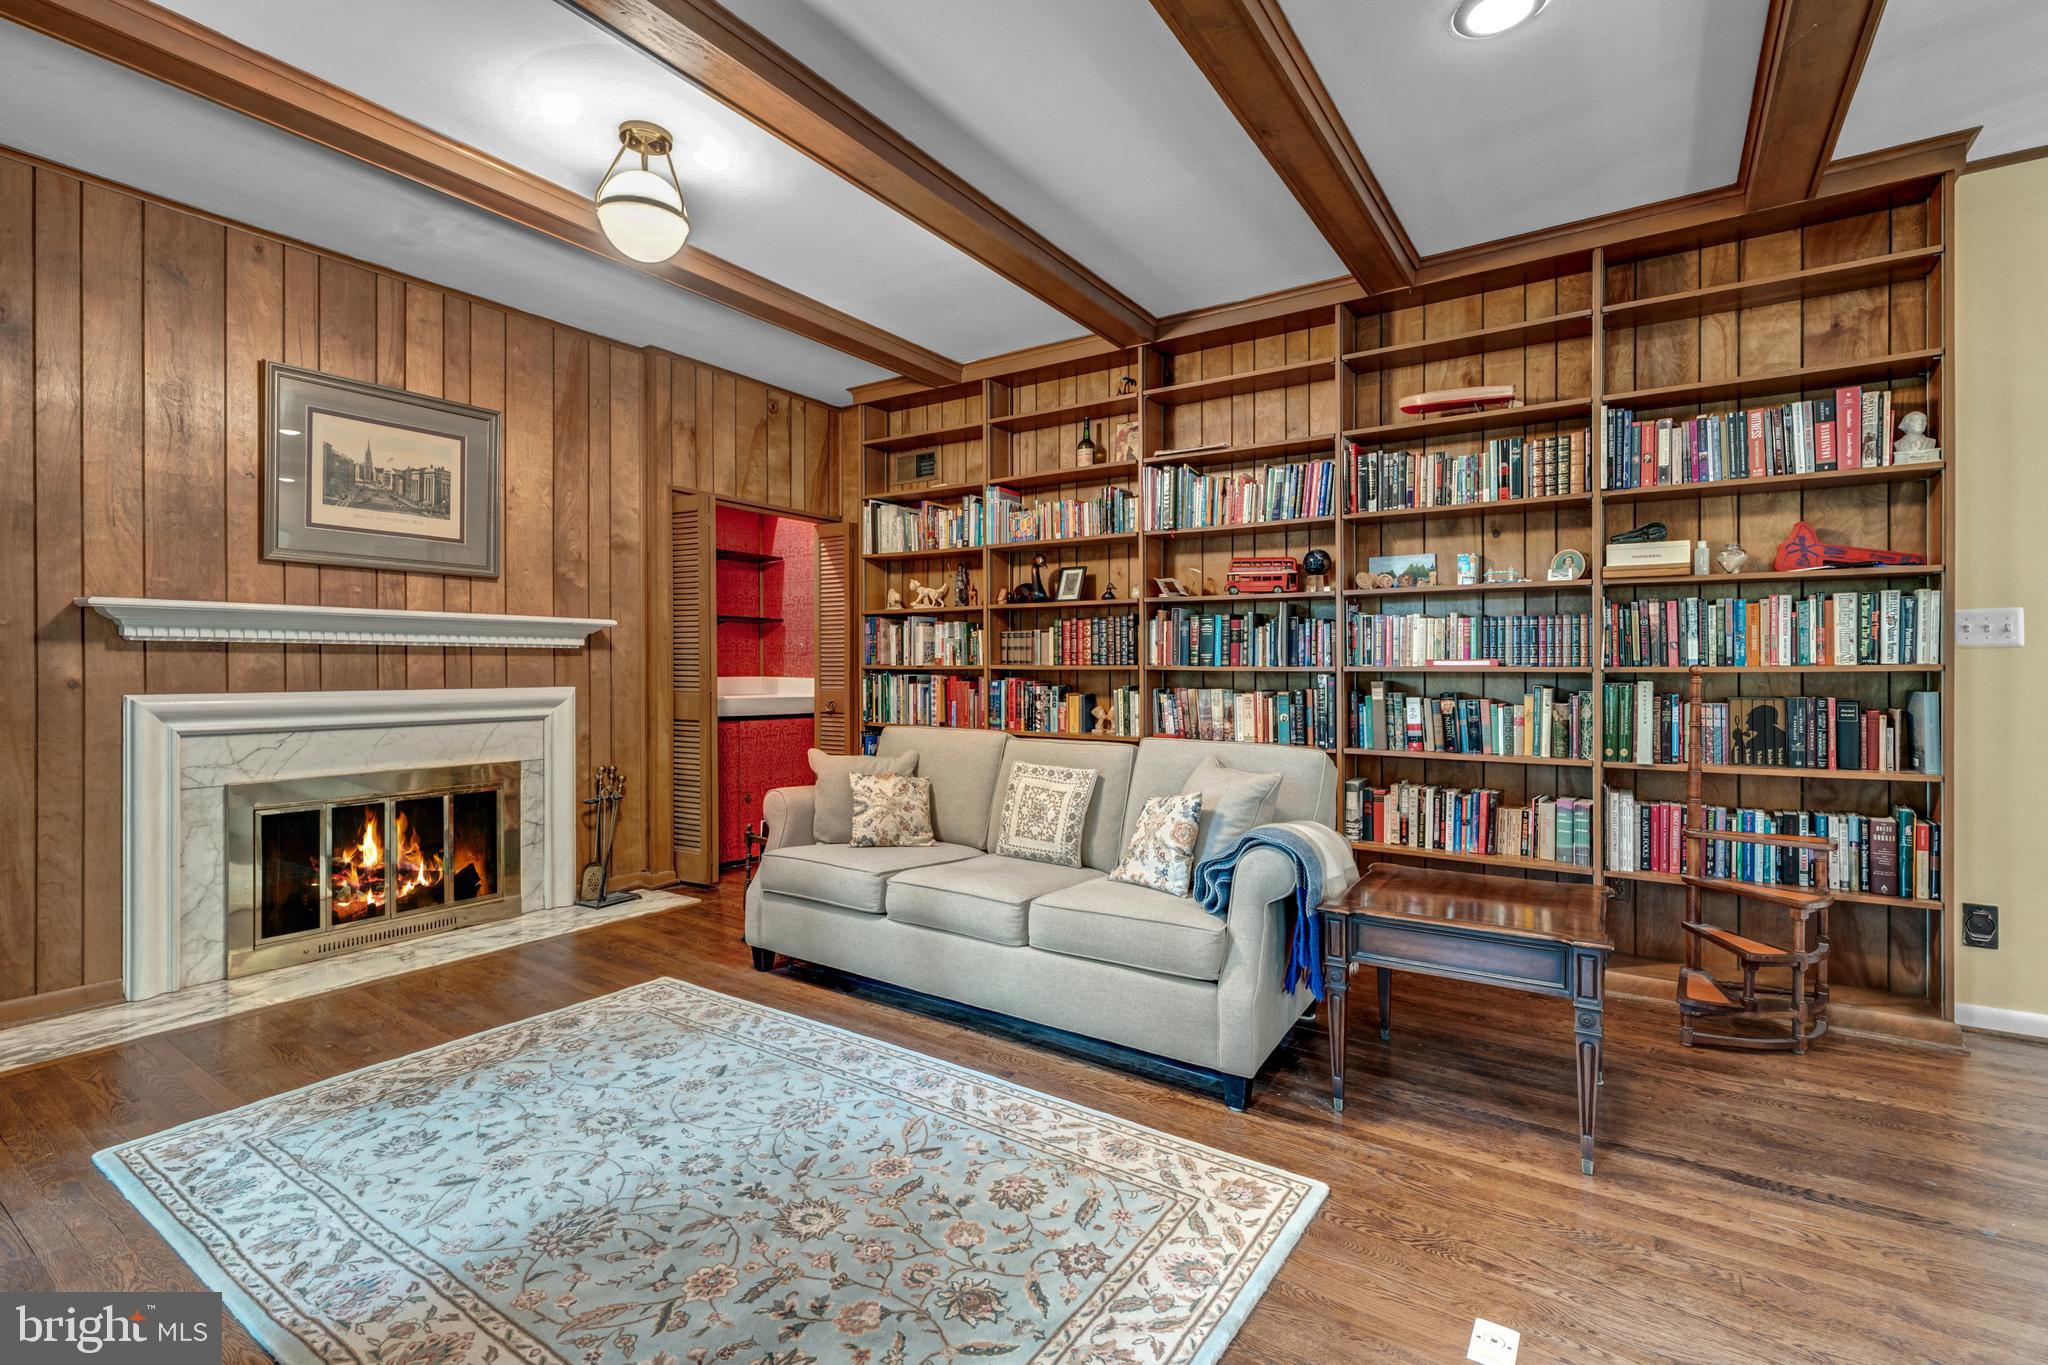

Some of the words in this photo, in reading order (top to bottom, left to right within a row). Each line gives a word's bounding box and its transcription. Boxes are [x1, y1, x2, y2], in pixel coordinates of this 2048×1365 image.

[1751, 411, 1762, 439] WITNESS
[1820, 423, 1831, 459] WASHINGTON
[1861, 594, 1870, 604] The
[1861, 604, 1870, 617] Bear
[1871, 610, 1880, 622] Tom
[1861, 617, 1870, 628] and
[1871, 622, 1880, 640] Clancy
[1861, 628, 1870, 638] The
[1905, 628, 1913, 645] Patriot
[1861, 638, 1870, 657] Dragon
[1905, 645, 1913, 663] Games
